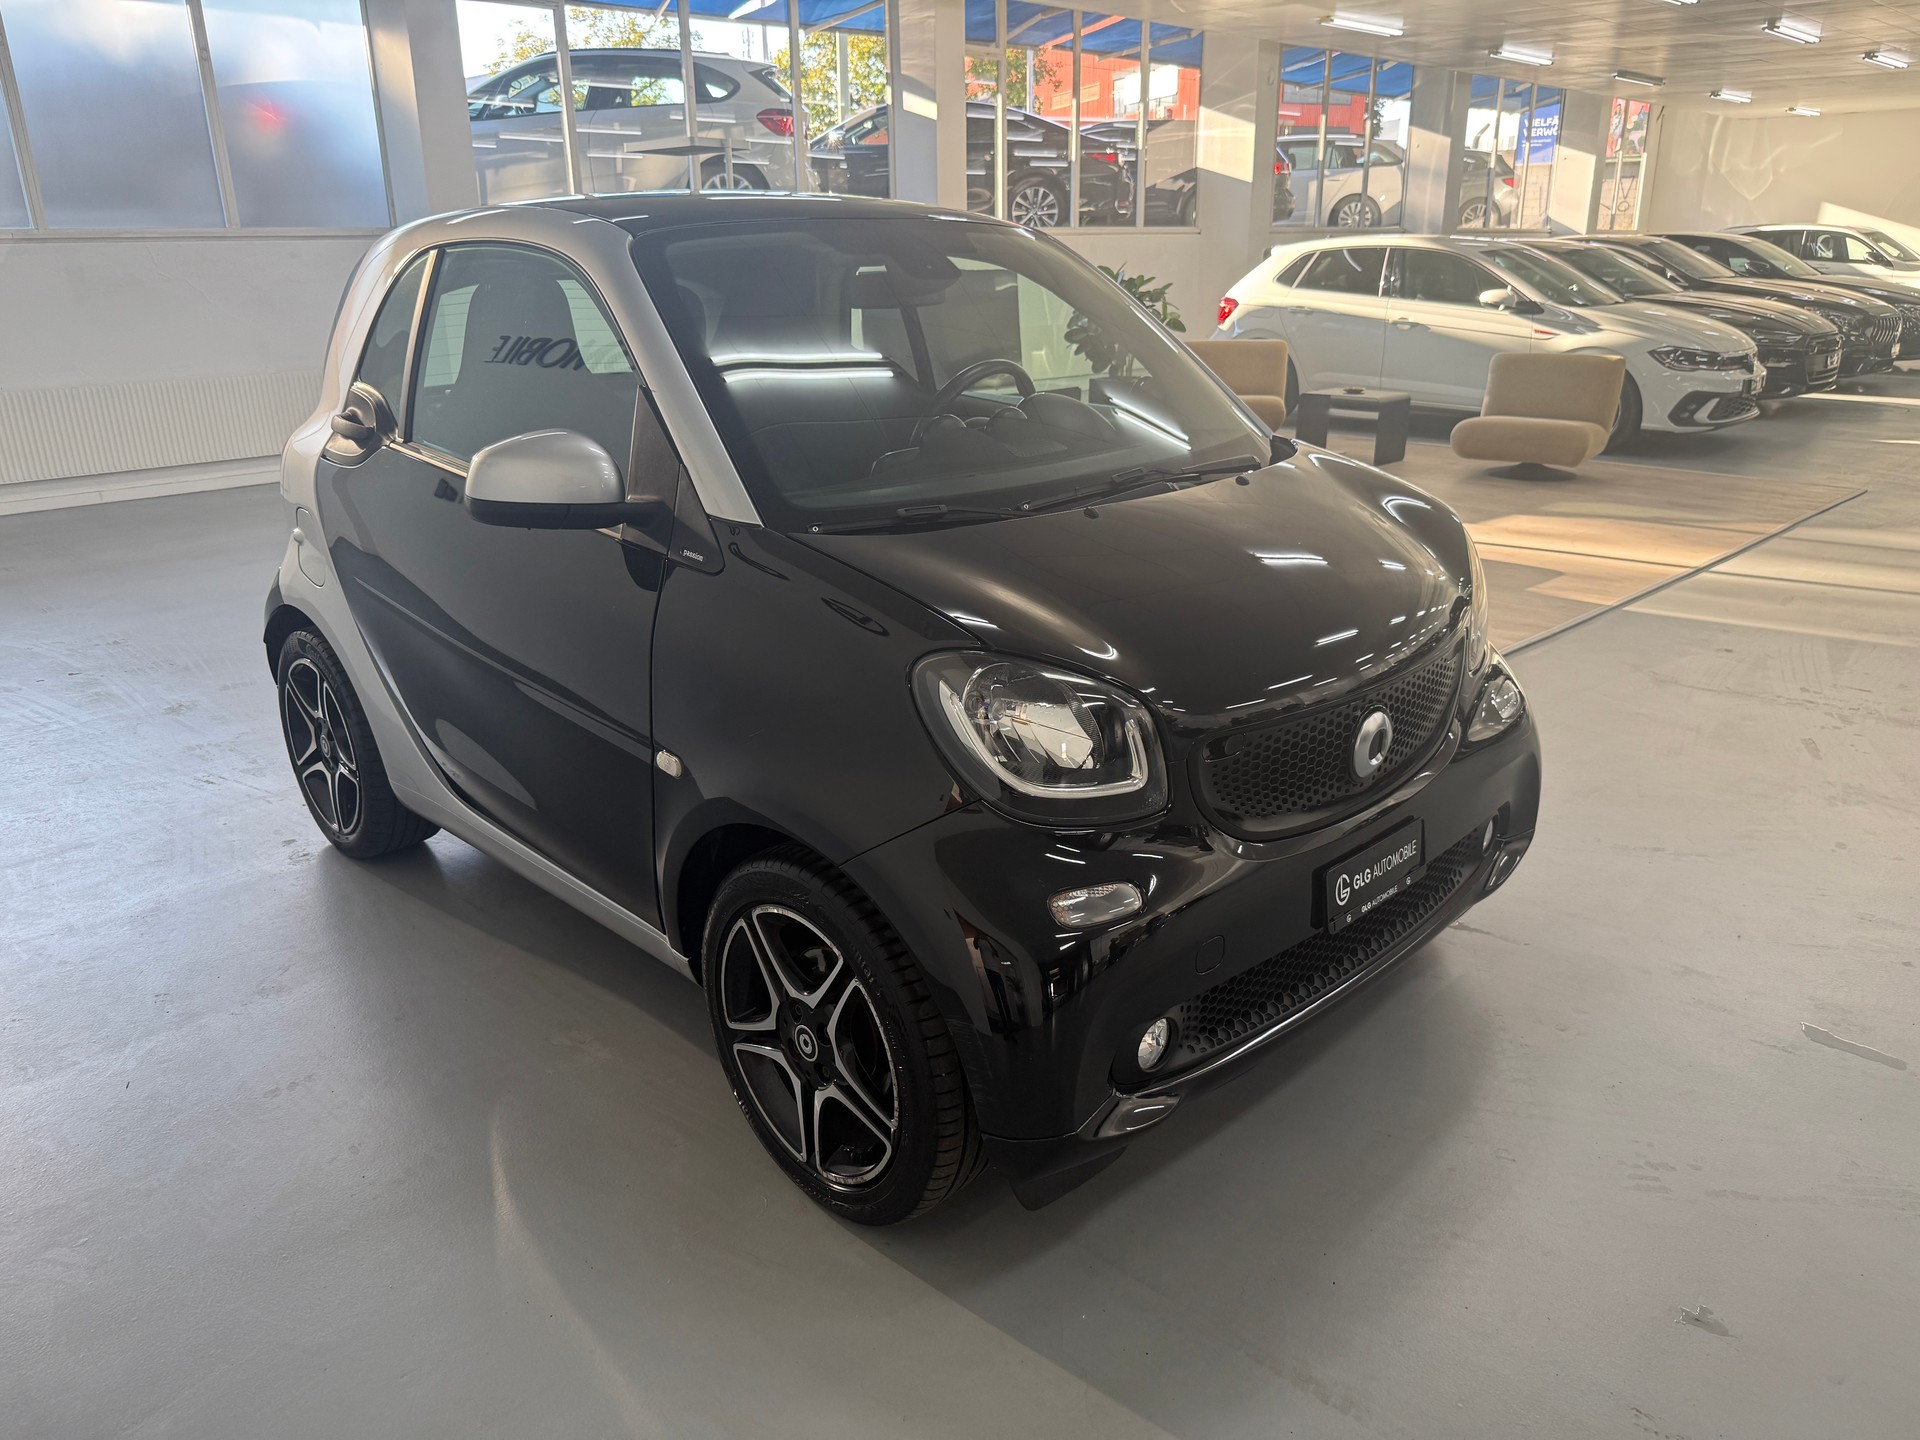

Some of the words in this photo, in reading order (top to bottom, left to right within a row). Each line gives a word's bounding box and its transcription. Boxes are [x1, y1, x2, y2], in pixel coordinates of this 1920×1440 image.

[682, 549, 704, 562] passion
[1353, 868, 1372, 890] GLG
[1373, 839, 1417, 879] AUTOMOBILE
[1361, 901, 1372, 913] GLG
[1372, 885, 1398, 906] AUTOMOBILE
